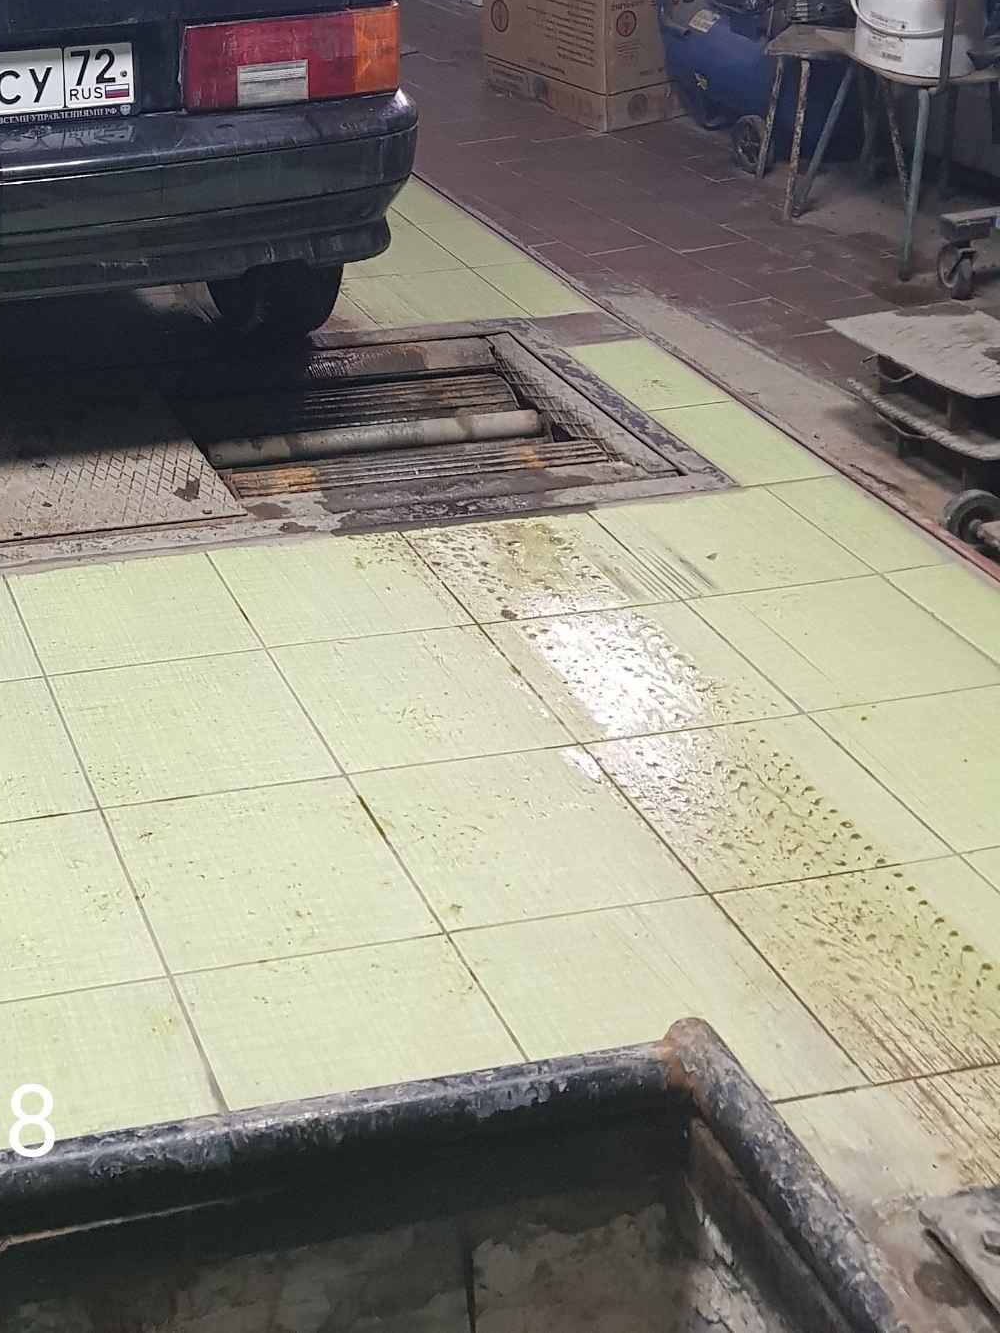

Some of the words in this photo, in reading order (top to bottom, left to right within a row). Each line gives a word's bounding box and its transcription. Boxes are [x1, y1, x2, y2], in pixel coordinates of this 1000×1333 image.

[69, 48, 116, 87] 72
[69, 86, 103, 102] RUS
[0, 115, 30, 125] ВСЕМИ
[30, 108, 104, 122] УПРАВЛЕНИЯМИ
[105, 107, 117, 115] РФ
